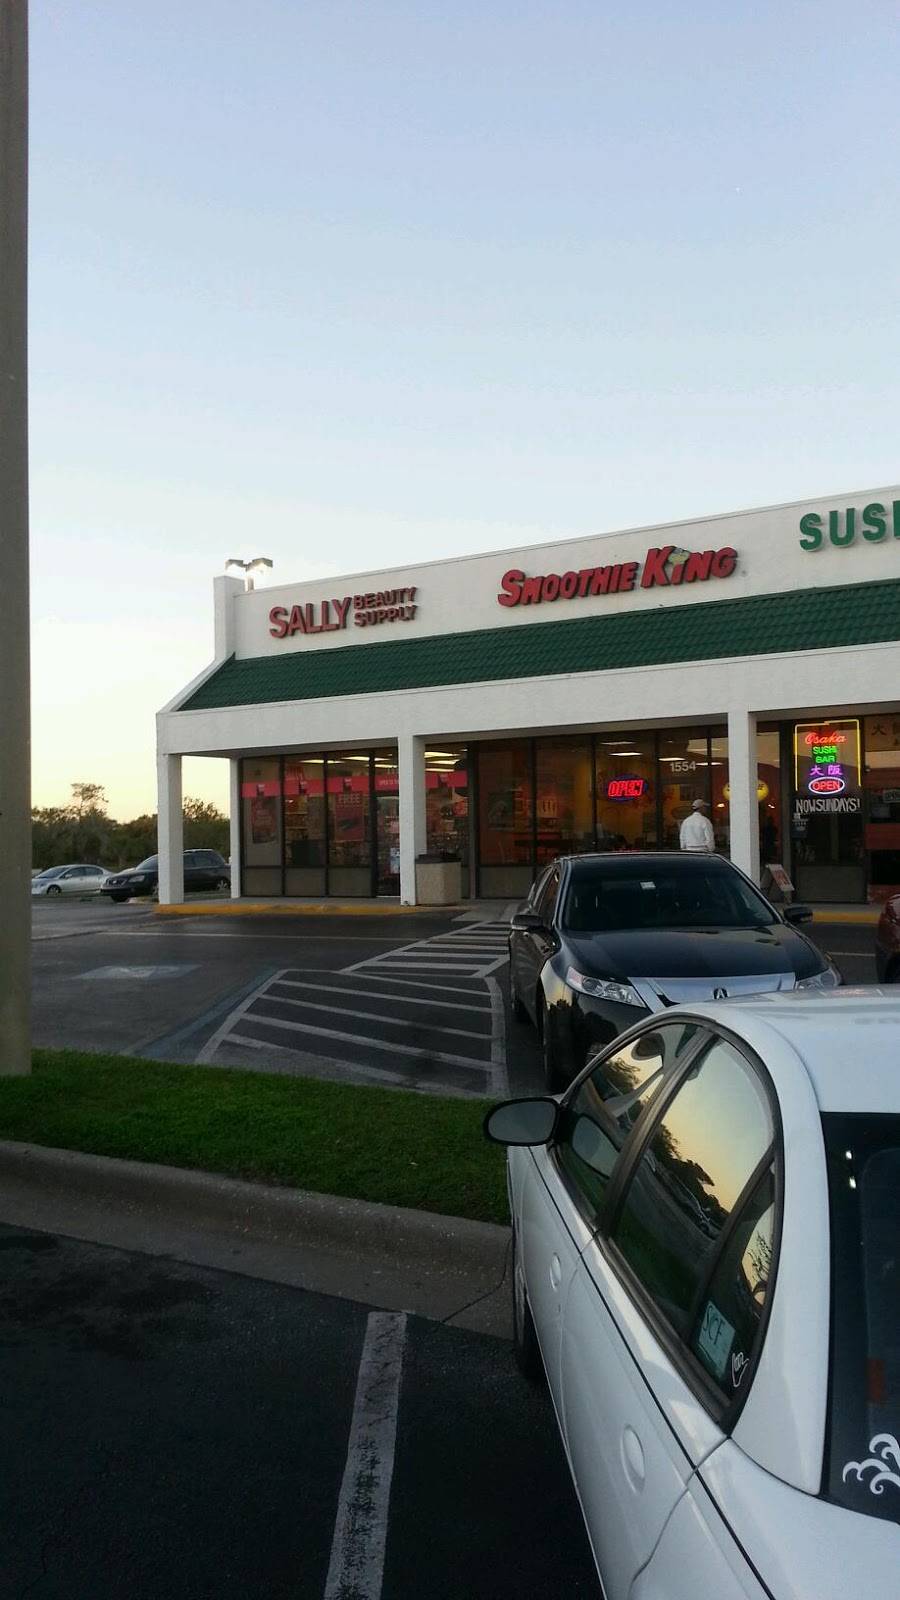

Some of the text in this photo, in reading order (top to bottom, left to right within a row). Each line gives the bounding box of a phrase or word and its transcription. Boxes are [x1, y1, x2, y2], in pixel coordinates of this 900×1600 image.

[498, 546, 738, 607] SMOOTHIE KING
[353, 587, 418, 609] BEAUTY
[269, 597, 352, 638] SALLY
[354, 605, 418, 627] SUPPLY
[805, 732, 847, 744] Osaka
[812, 745, 837, 754] SUSHI
[669, 761, 697, 773] 1554
[608, 780, 644, 797] OPEN
[812, 780, 840, 791] OPEN
